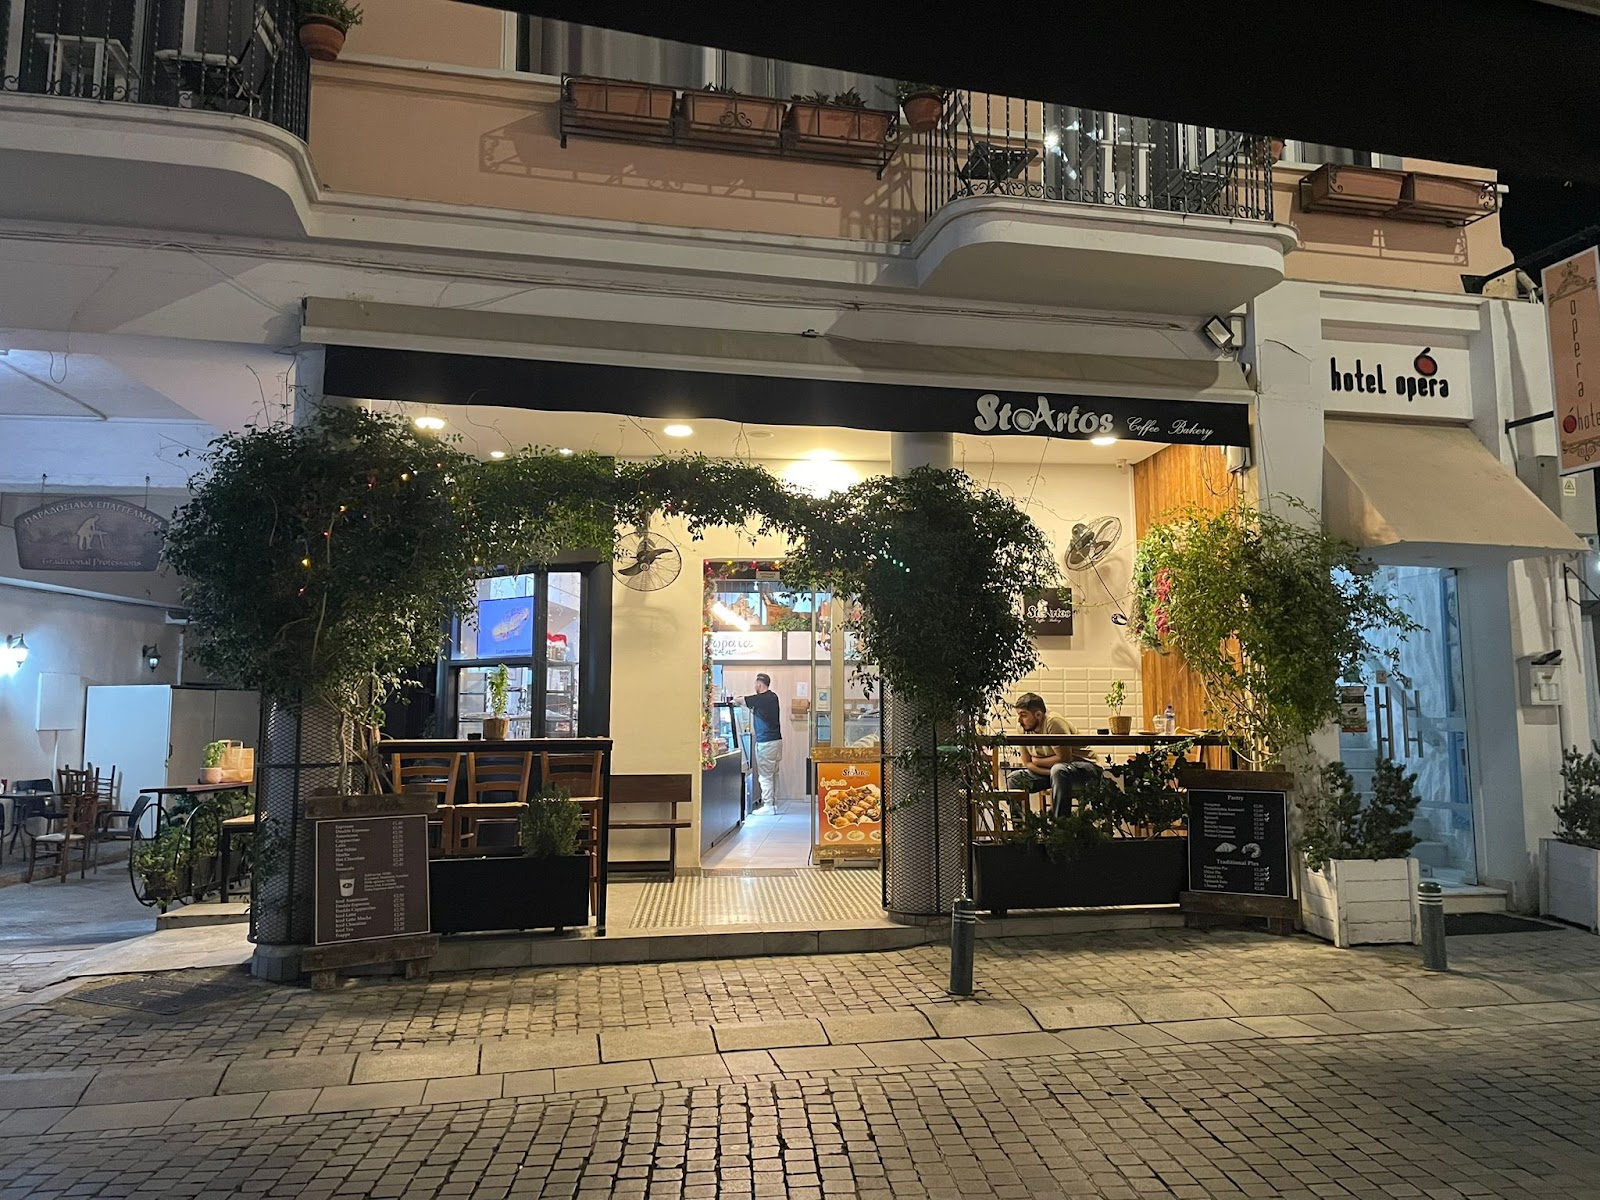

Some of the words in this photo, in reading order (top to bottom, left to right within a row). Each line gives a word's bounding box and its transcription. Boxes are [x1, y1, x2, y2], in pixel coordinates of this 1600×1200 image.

[1569, 299, 1584, 398] opera
[1330, 356, 1387, 394] hotel
[1395, 376, 1449, 402] opera
[1126, 416, 1160, 437] Coffee
[1167, 419, 1214, 441] Bakery
[24, 500, 94, 526] ΠΑΡΑΔΟΣΙΑΚΑ
[97, 501, 163, 529] ΕΠΑΓΓΕΛΜΑΤΑ
[93, 558, 142, 567] Professions
